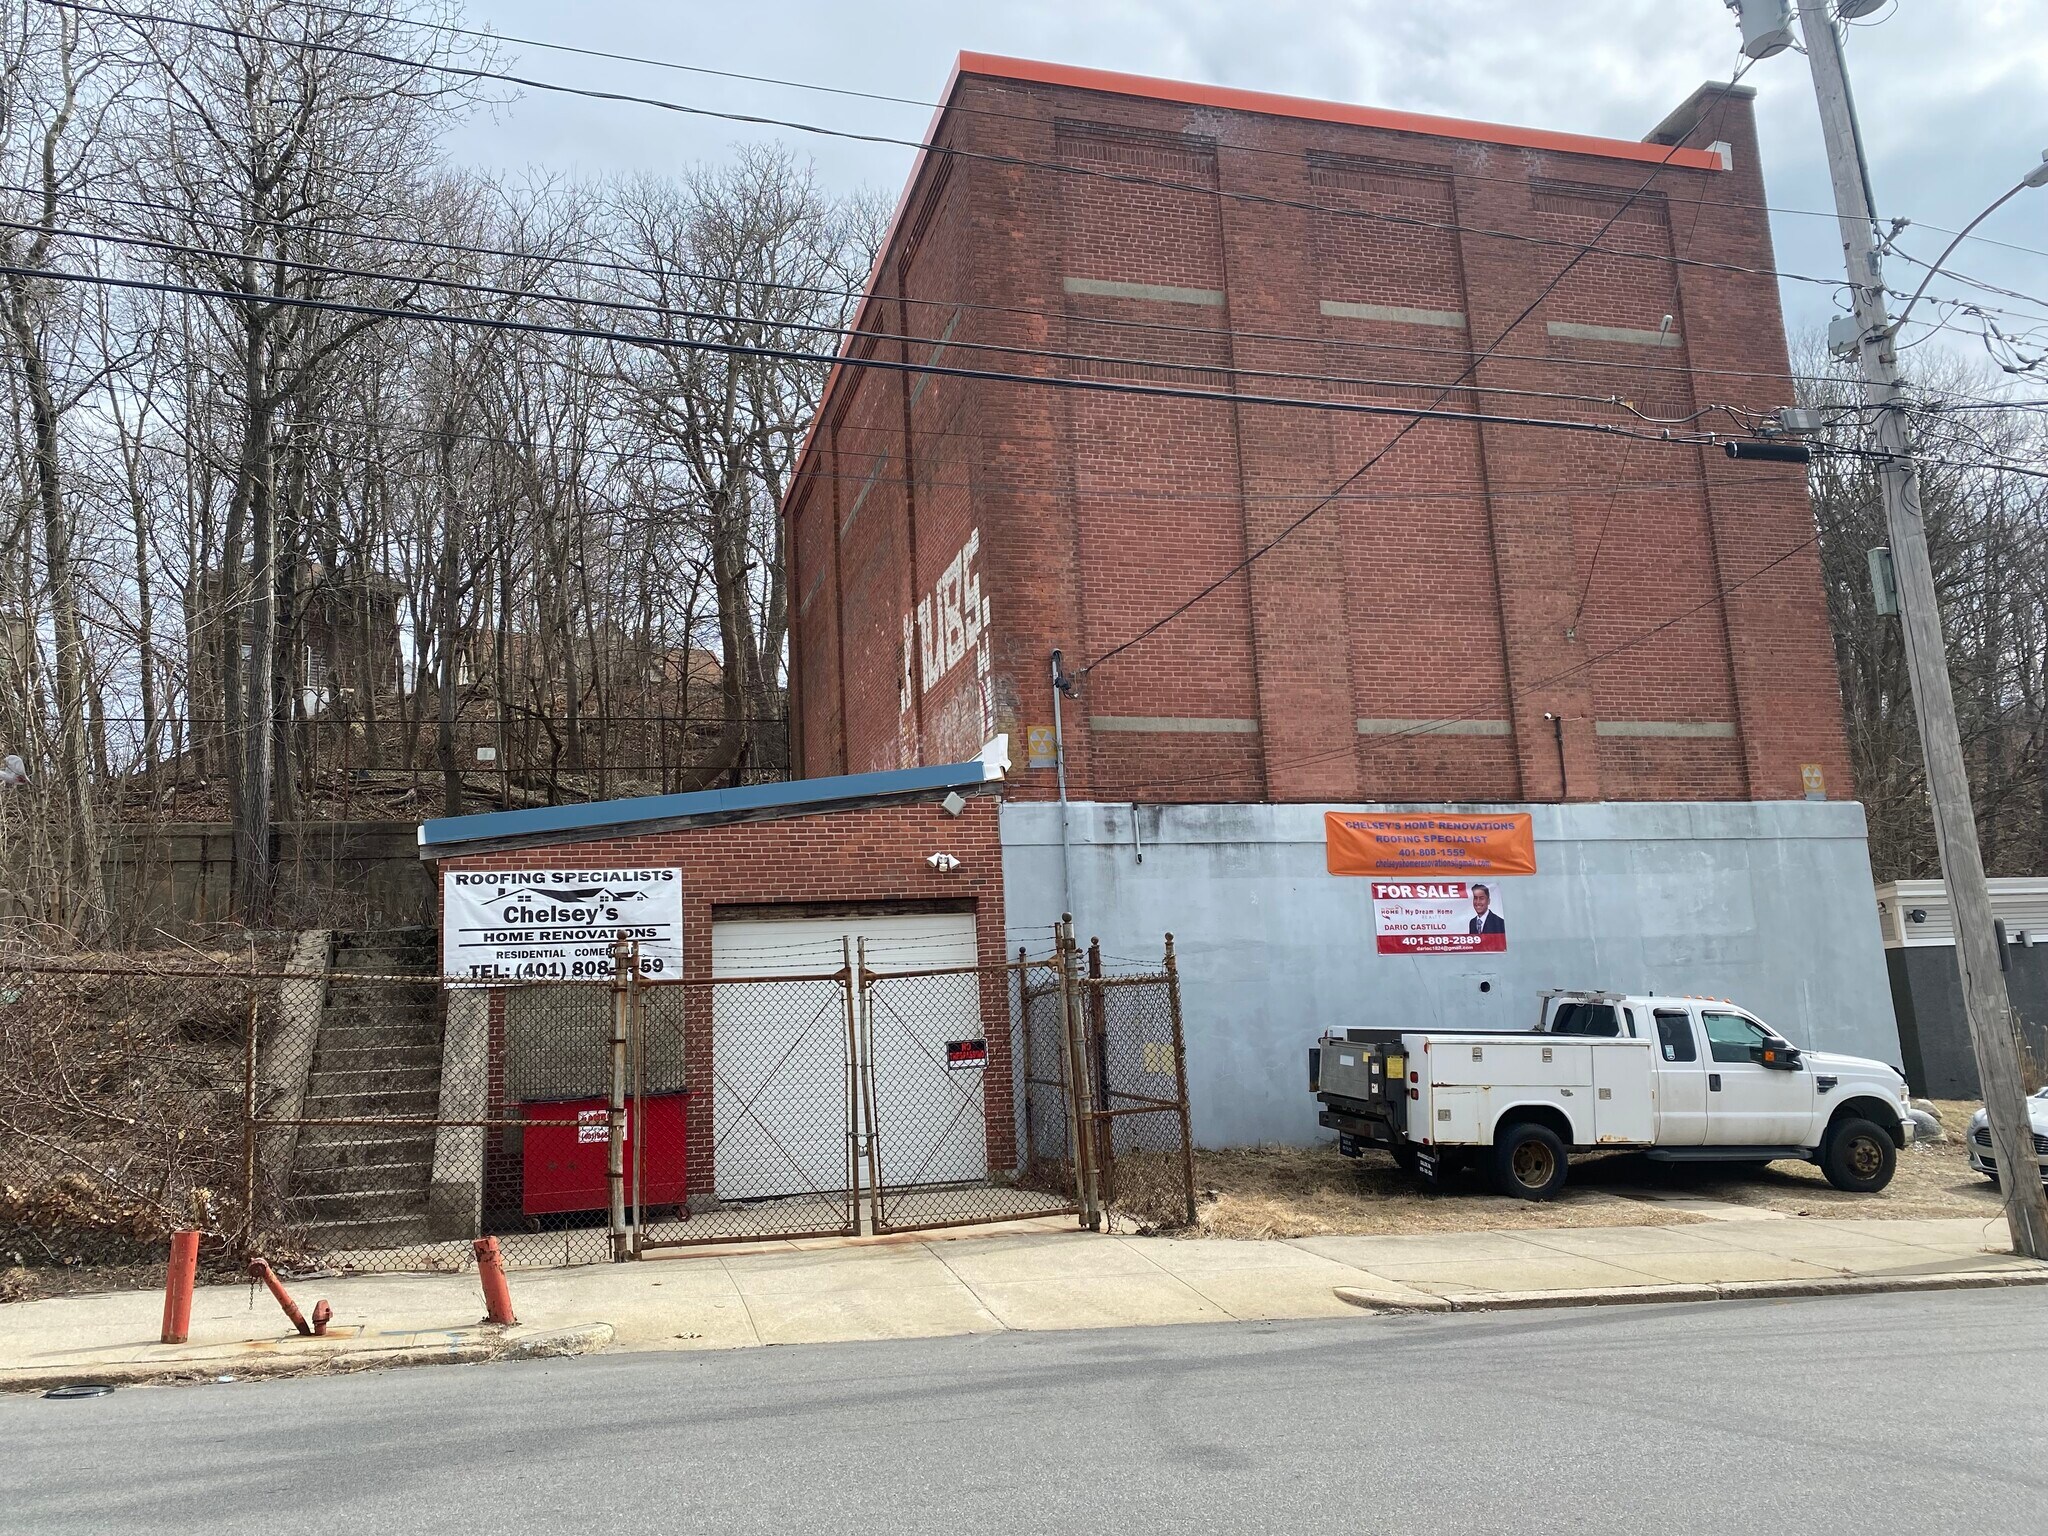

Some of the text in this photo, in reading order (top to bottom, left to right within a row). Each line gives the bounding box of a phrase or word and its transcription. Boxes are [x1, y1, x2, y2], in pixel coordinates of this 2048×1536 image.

[1346, 821, 1515, 830] CHELSEY'S HOME RENOVATIONS
[1376, 835, 1487, 843] ROOFING SPECIALIST
[1398, 848, 1466, 857] 401-808-1559
[456, 870, 673, 885] ROOFING SPECIALISTS
[1377, 885, 1460, 898] FOR SALE
[503, 904, 619, 925] Chelsey's
[484, 928, 657, 942] HOME RENOVATONS
[1402, 936, 1482, 945] 401-808-2889
[496, 949, 566, 959] RESIDENTIAL
[469, 958, 664, 979] TEL: (401) 808-59
